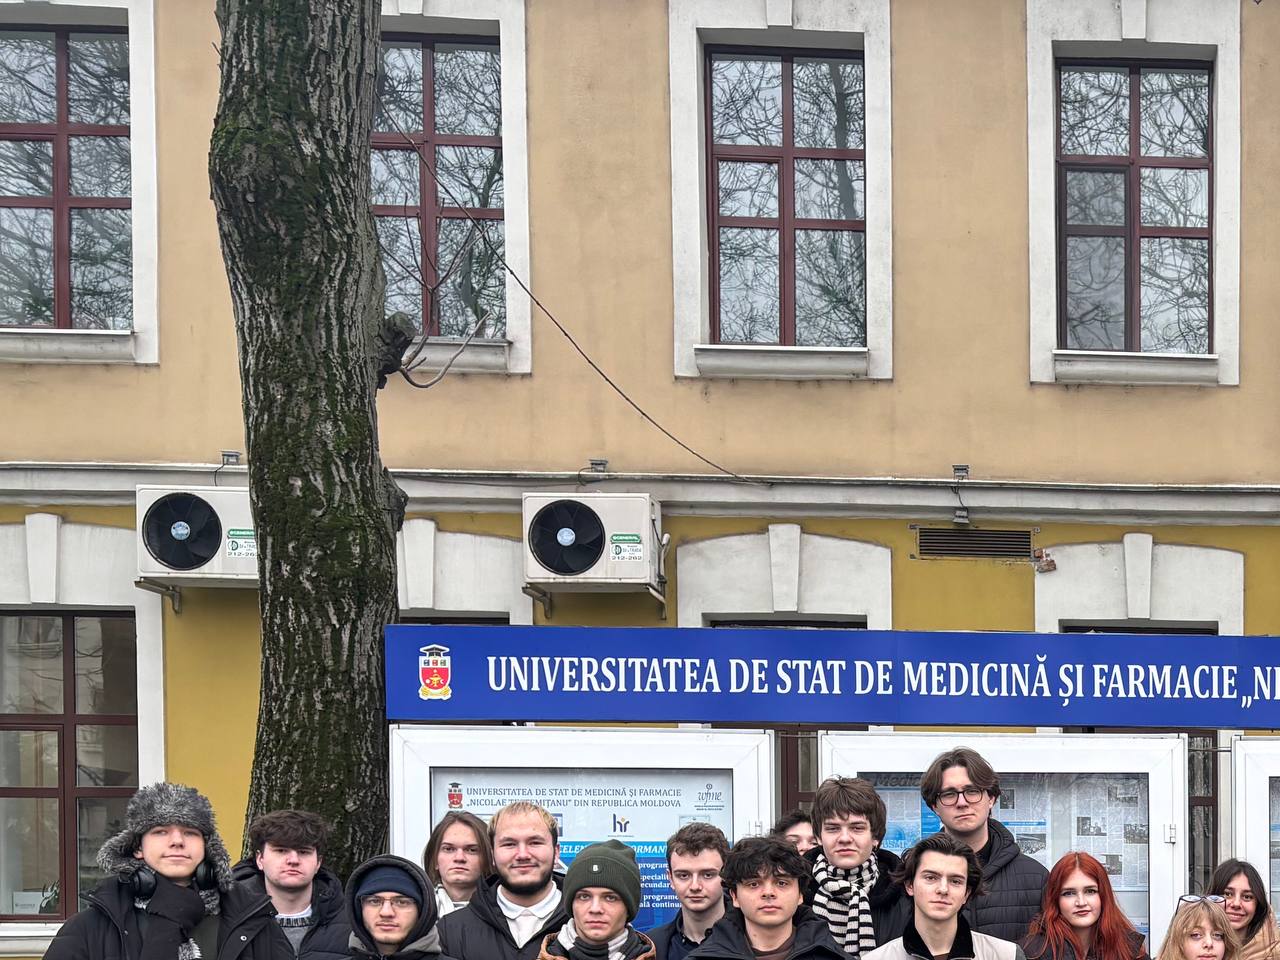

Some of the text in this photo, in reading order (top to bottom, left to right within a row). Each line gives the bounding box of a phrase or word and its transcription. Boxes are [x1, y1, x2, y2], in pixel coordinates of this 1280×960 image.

[486, 656, 722, 692] UNIVERSITATEA
[728, 658, 769, 693] DE
[776, 659, 846, 694] STAT
[854, 660, 893, 695] DE
[903, 654, 1052, 697] MEDICINĂ
[1058, 663, 1085, 707] ȘI
[1092, 664, 1238, 699] FARMACIE
[873, 774, 921, 787] Medic
[466, 787, 533, 796] UNIVERSITATEA
[535, 788, 547, 796] DE
[548, 788, 570, 796] STAT
[571, 788, 583, 797] DE
[584, 787, 627, 797] MEDICINĂ
[638, 788, 682, 797] FARMACIE
[573, 799, 589, 807] DIN
[591, 799, 639, 807] REPUBLICA
[640, 799, 681, 808] MOLDOVA
